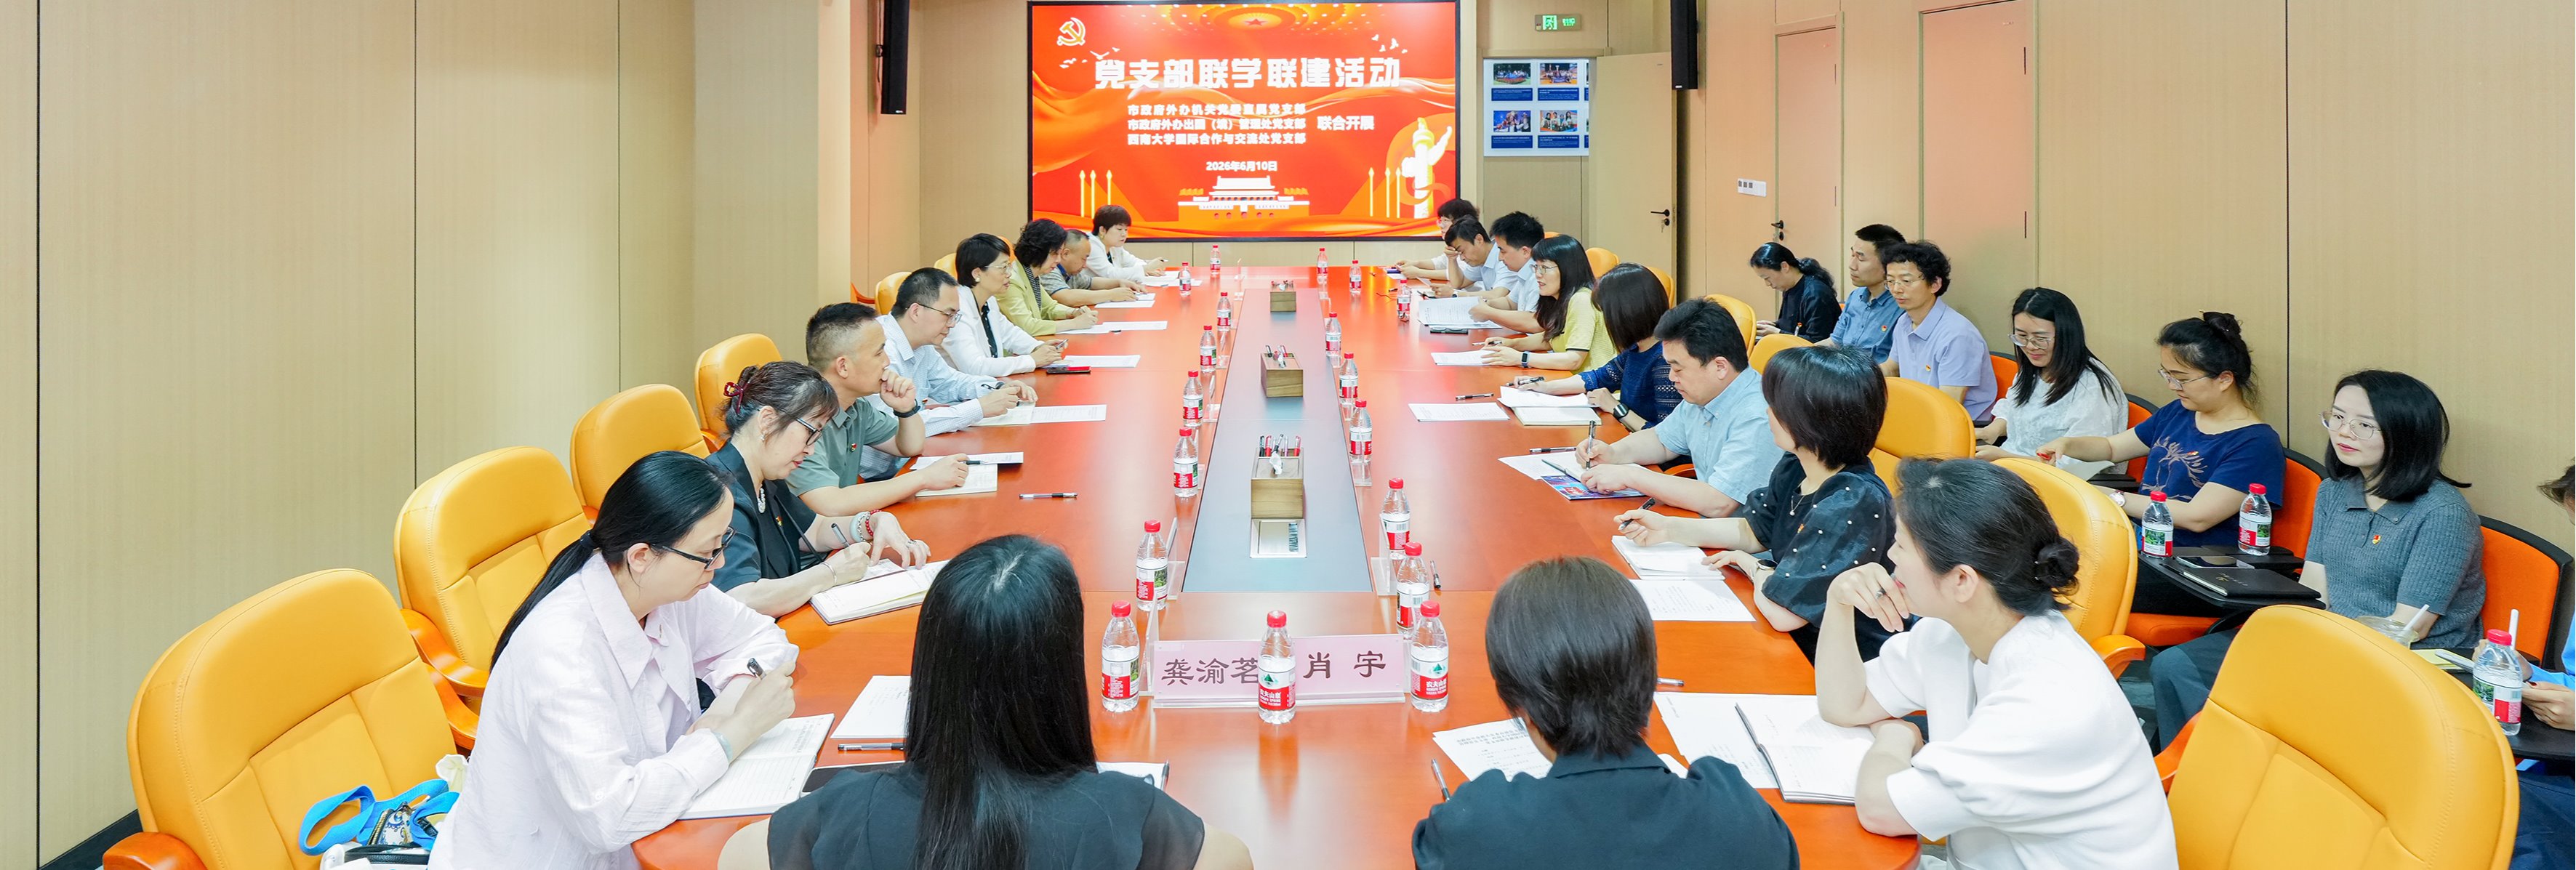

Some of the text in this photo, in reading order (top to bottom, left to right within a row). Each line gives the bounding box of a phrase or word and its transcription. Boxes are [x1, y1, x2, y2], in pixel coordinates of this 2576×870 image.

[1095, 57, 1400, 89] 党支部联学联建活动
[1317, 116, 1375, 131] 联合开展
[1128, 133, 1307, 145] 西南大学国际合作与交流处党支部
[1205, 161, 1278, 172] 2026年6月10日
[1162, 657, 1259, 686] 龚渝茗
